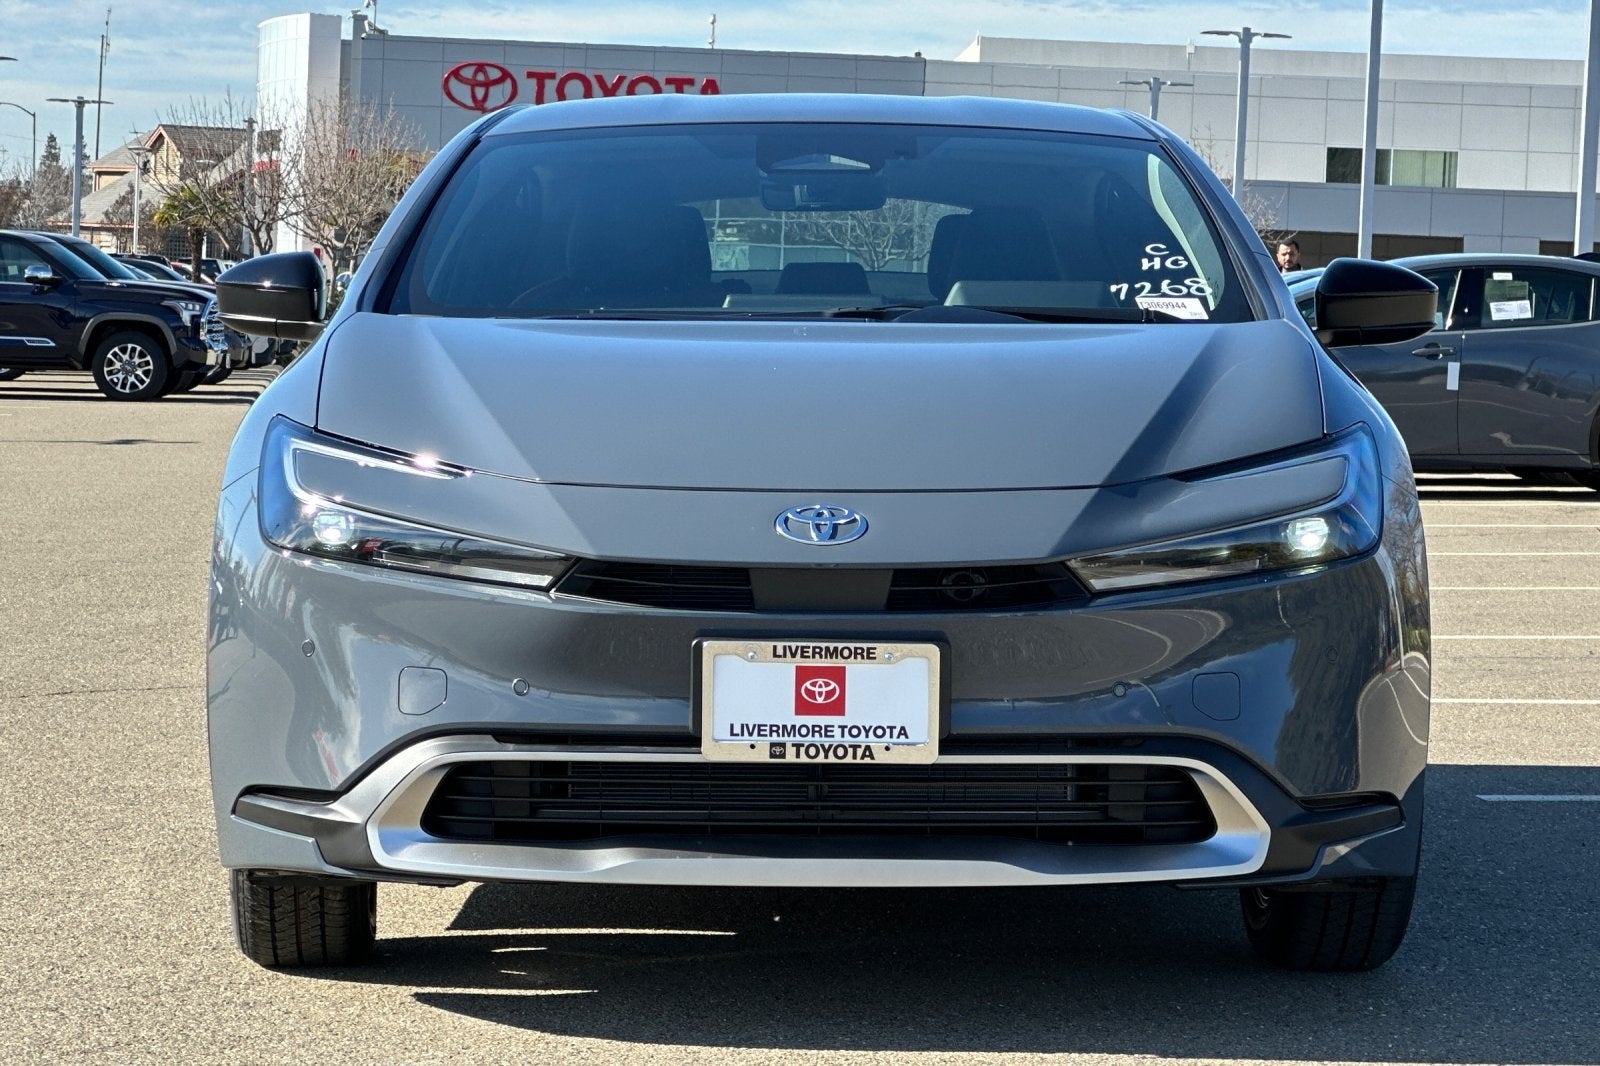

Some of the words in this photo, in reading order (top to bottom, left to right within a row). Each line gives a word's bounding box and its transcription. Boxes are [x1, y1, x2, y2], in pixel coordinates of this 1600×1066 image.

[1145, 243, 1170, 255] C
[1110, 278, 1213, 301] 7268
[772, 645, 877, 661] LIVERMORE
[729, 723, 835, 739] LIVERMORE
[838, 724, 909, 739] TOYOTA
[791, 743, 876, 760] TOYOTA
